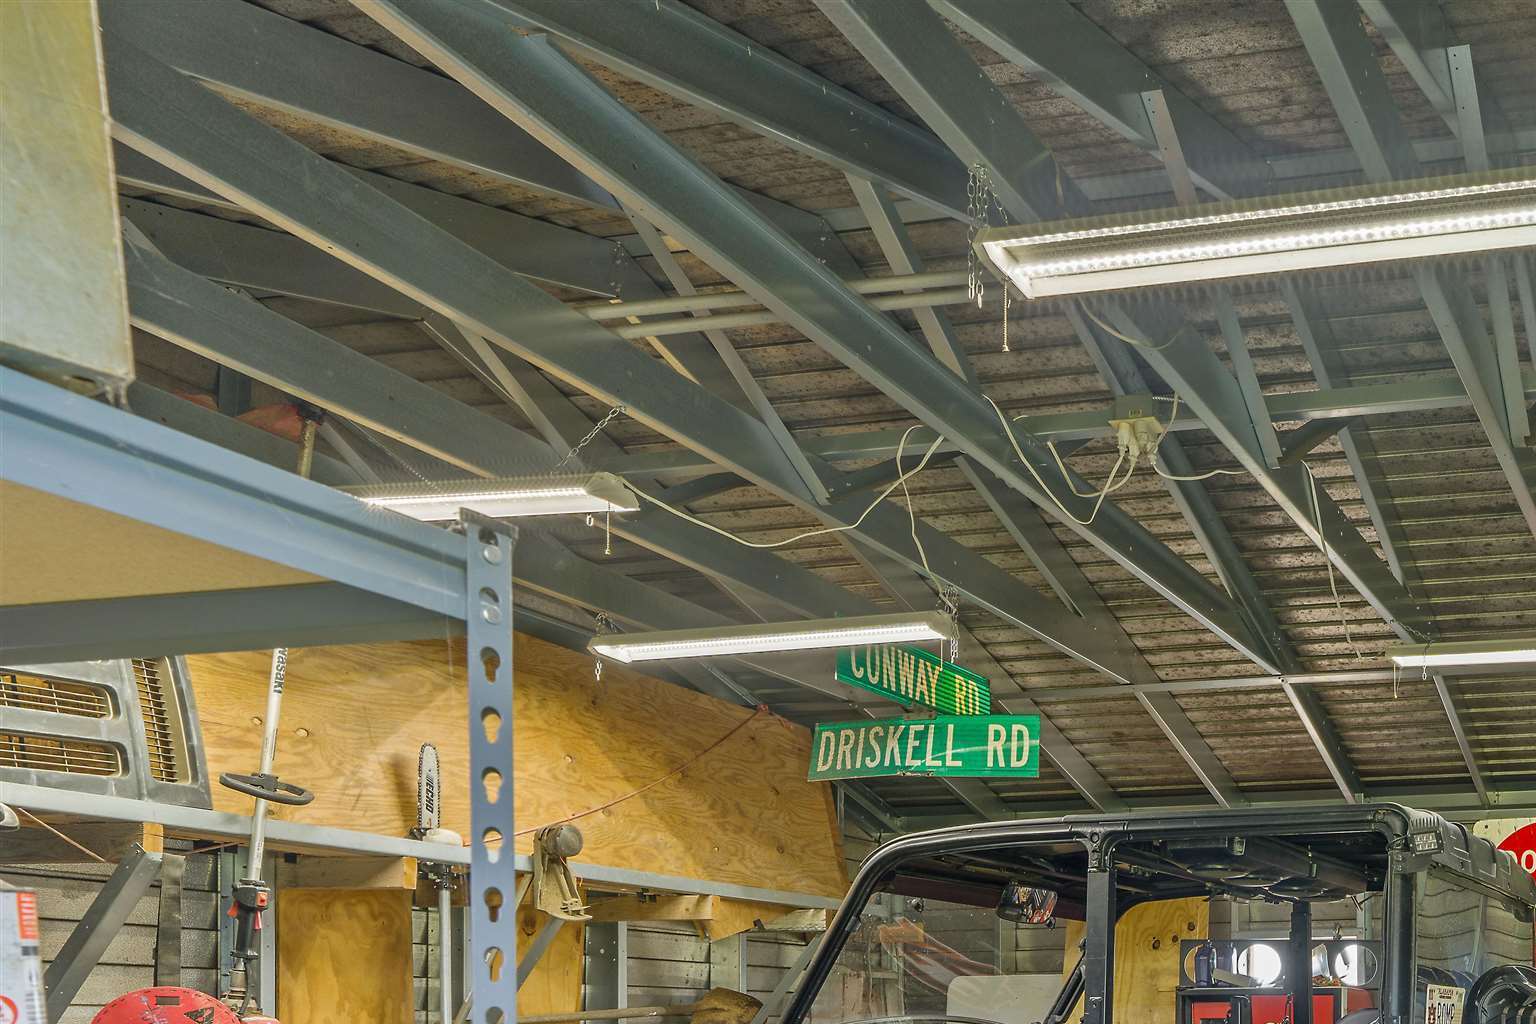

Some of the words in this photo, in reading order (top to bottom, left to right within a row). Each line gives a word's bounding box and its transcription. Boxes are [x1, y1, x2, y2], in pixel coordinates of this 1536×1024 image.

[851, 646, 941, 706] CONWAY
[955, 675, 980, 715] RD
[816, 724, 962, 772] DRISKELL
[987, 724, 1029, 768] RD
[425, 783, 434, 814] ECHO
